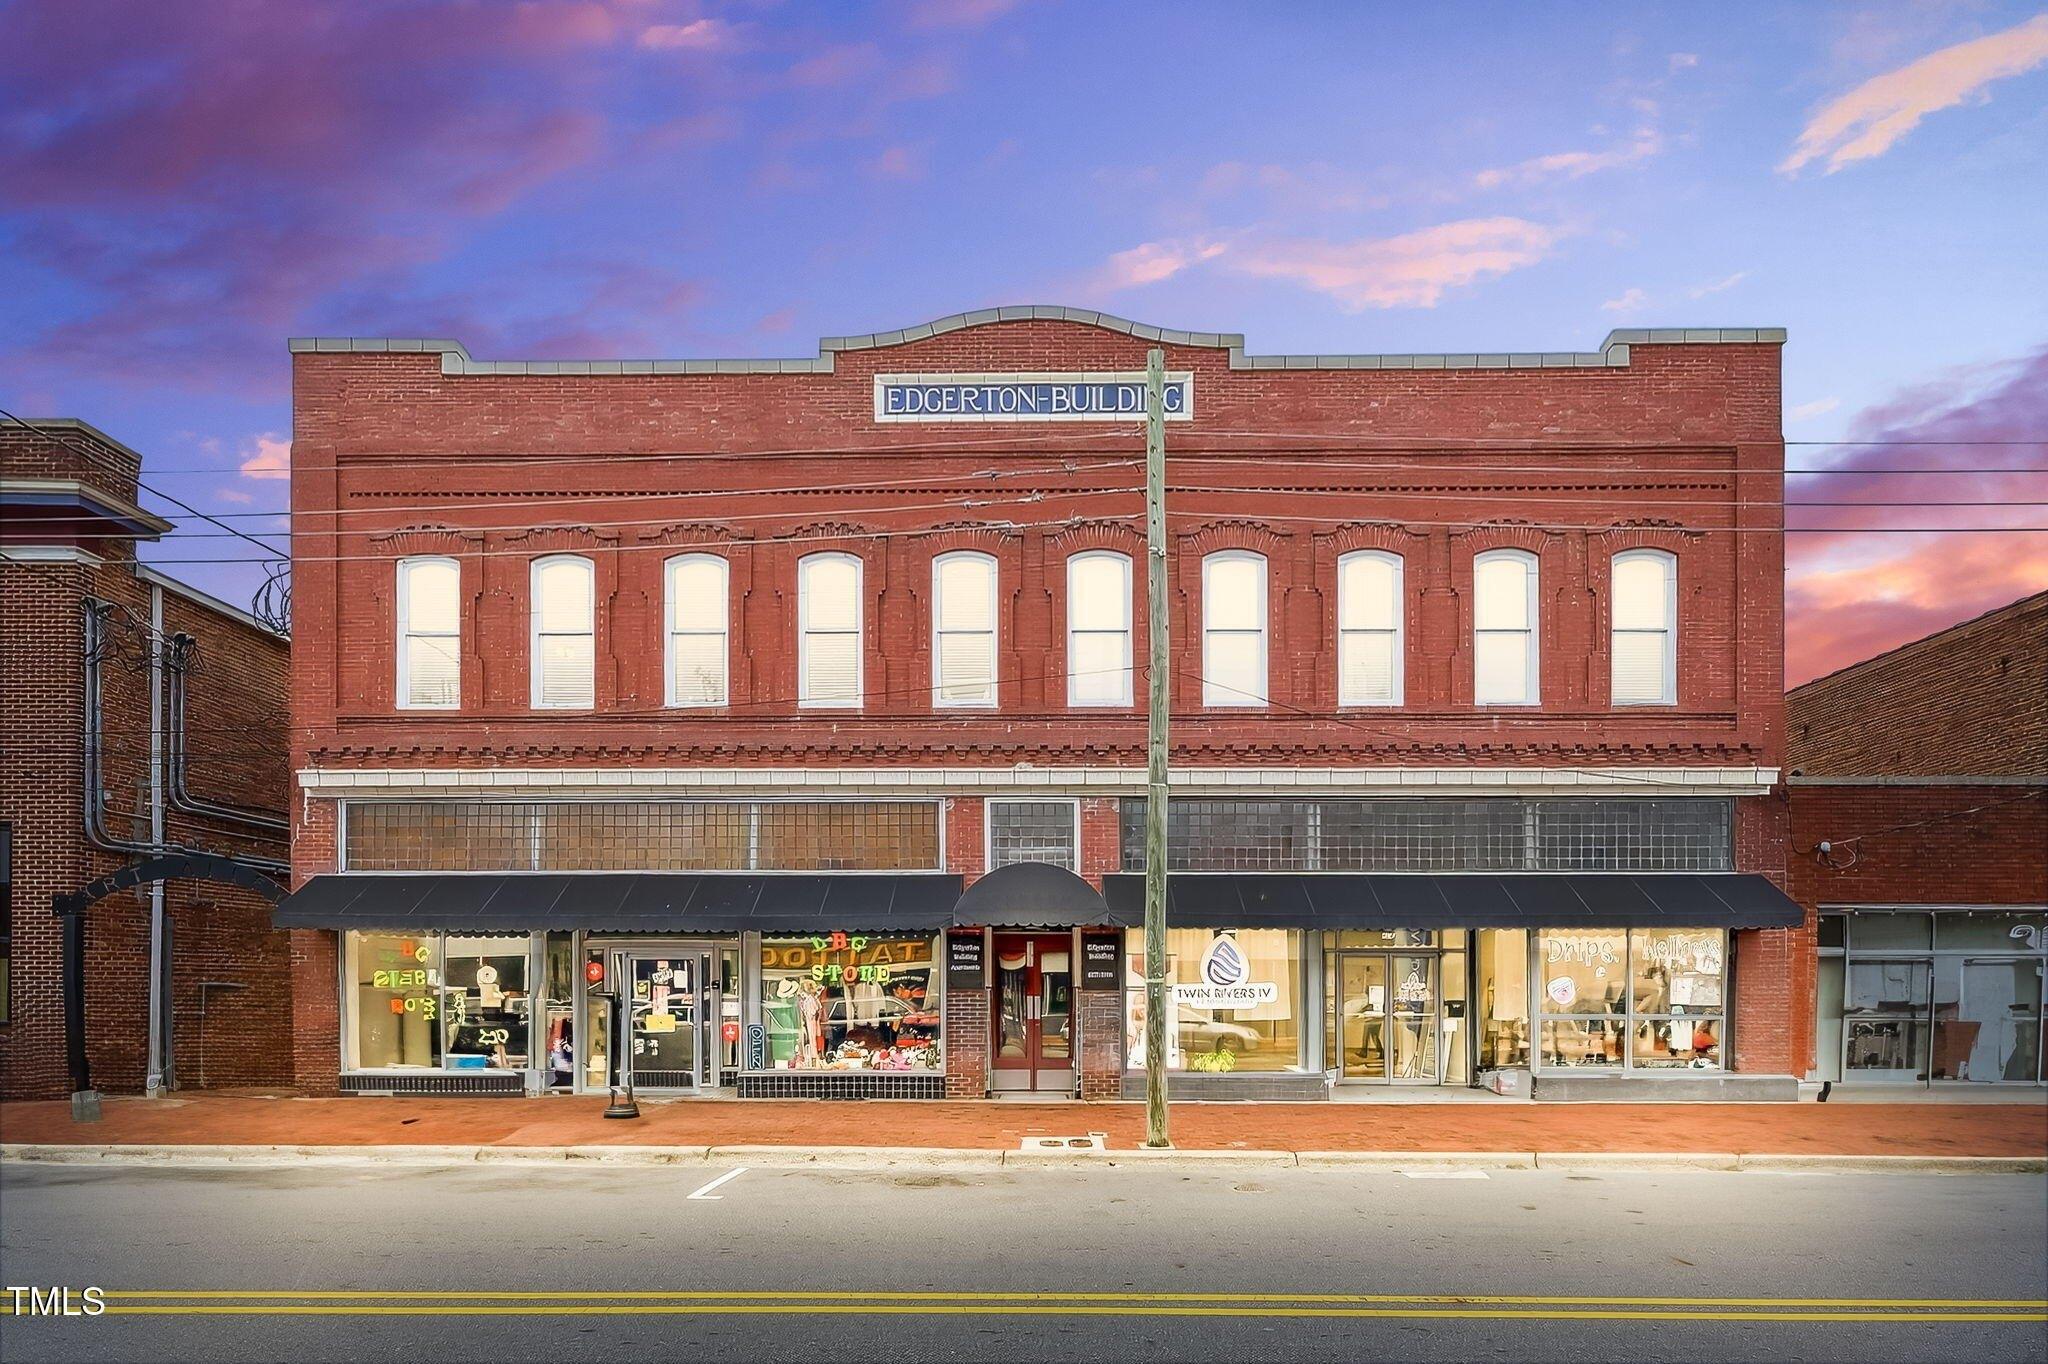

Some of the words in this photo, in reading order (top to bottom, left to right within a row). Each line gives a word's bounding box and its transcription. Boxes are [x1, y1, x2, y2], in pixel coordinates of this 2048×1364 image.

[1178, 988, 1211, 999] TWIN
[1214, 988, 1256, 999] RIVERS
[1258, 987, 1272, 998] IV
